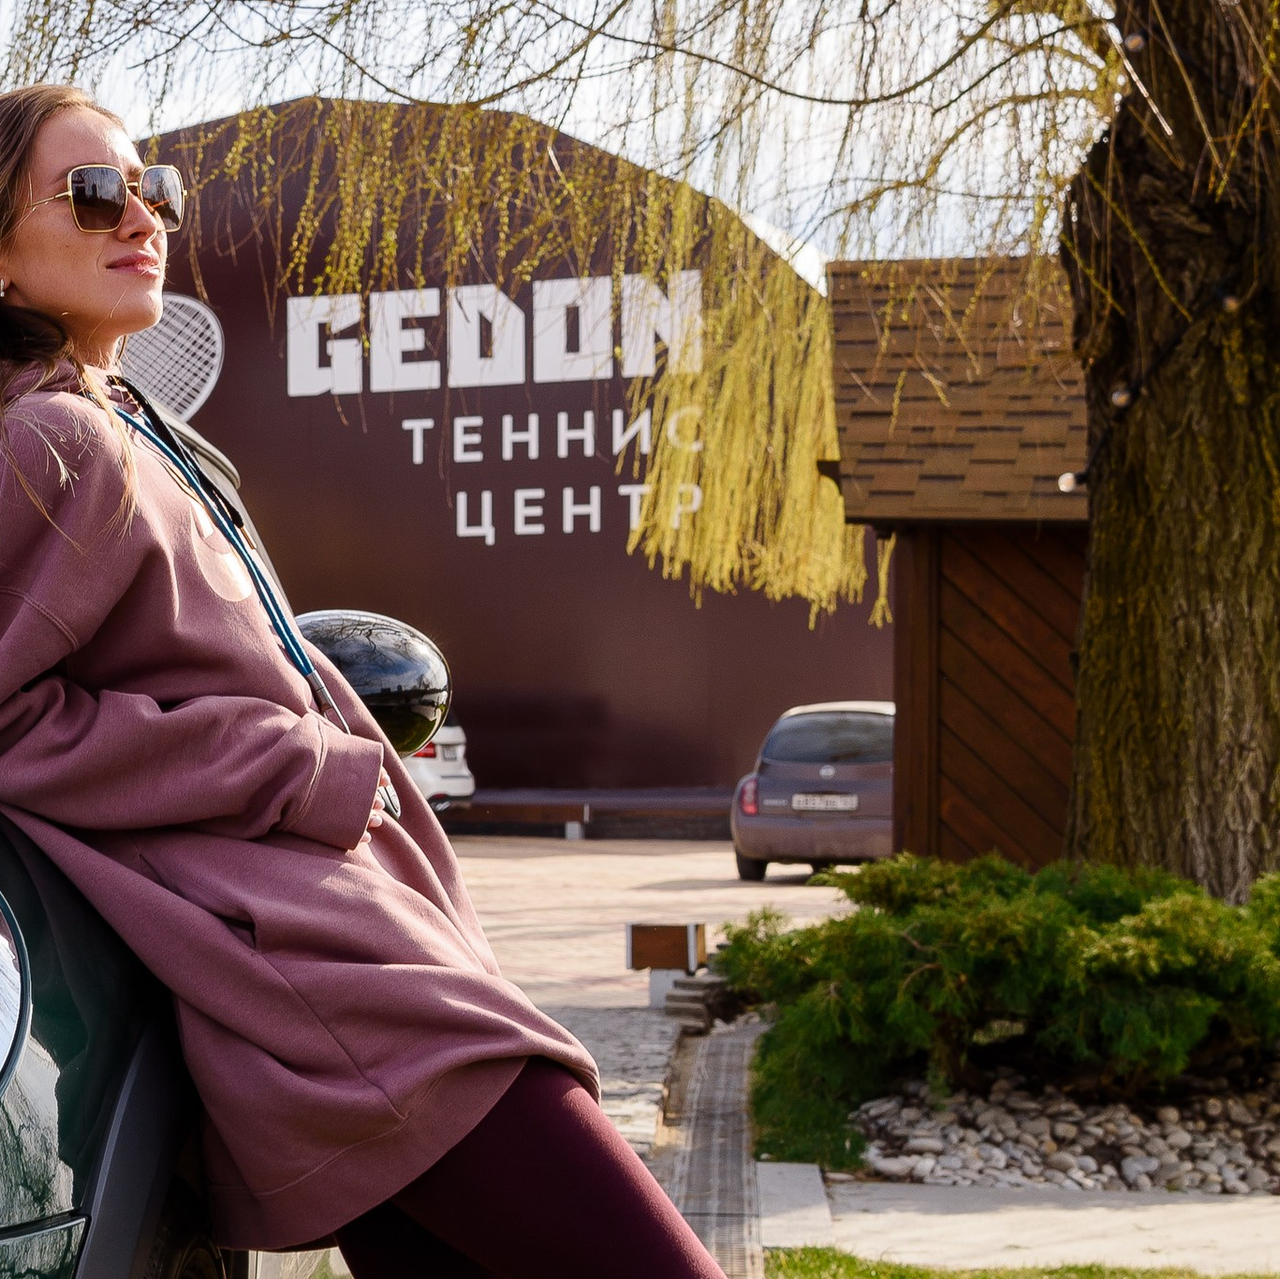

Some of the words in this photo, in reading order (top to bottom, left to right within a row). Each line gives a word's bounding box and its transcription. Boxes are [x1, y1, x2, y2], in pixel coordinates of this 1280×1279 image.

[287, 269, 703, 396] GEDON
[402, 406, 703, 464] ТЕННИС
[456, 484, 703, 546] ЦЕНТР
